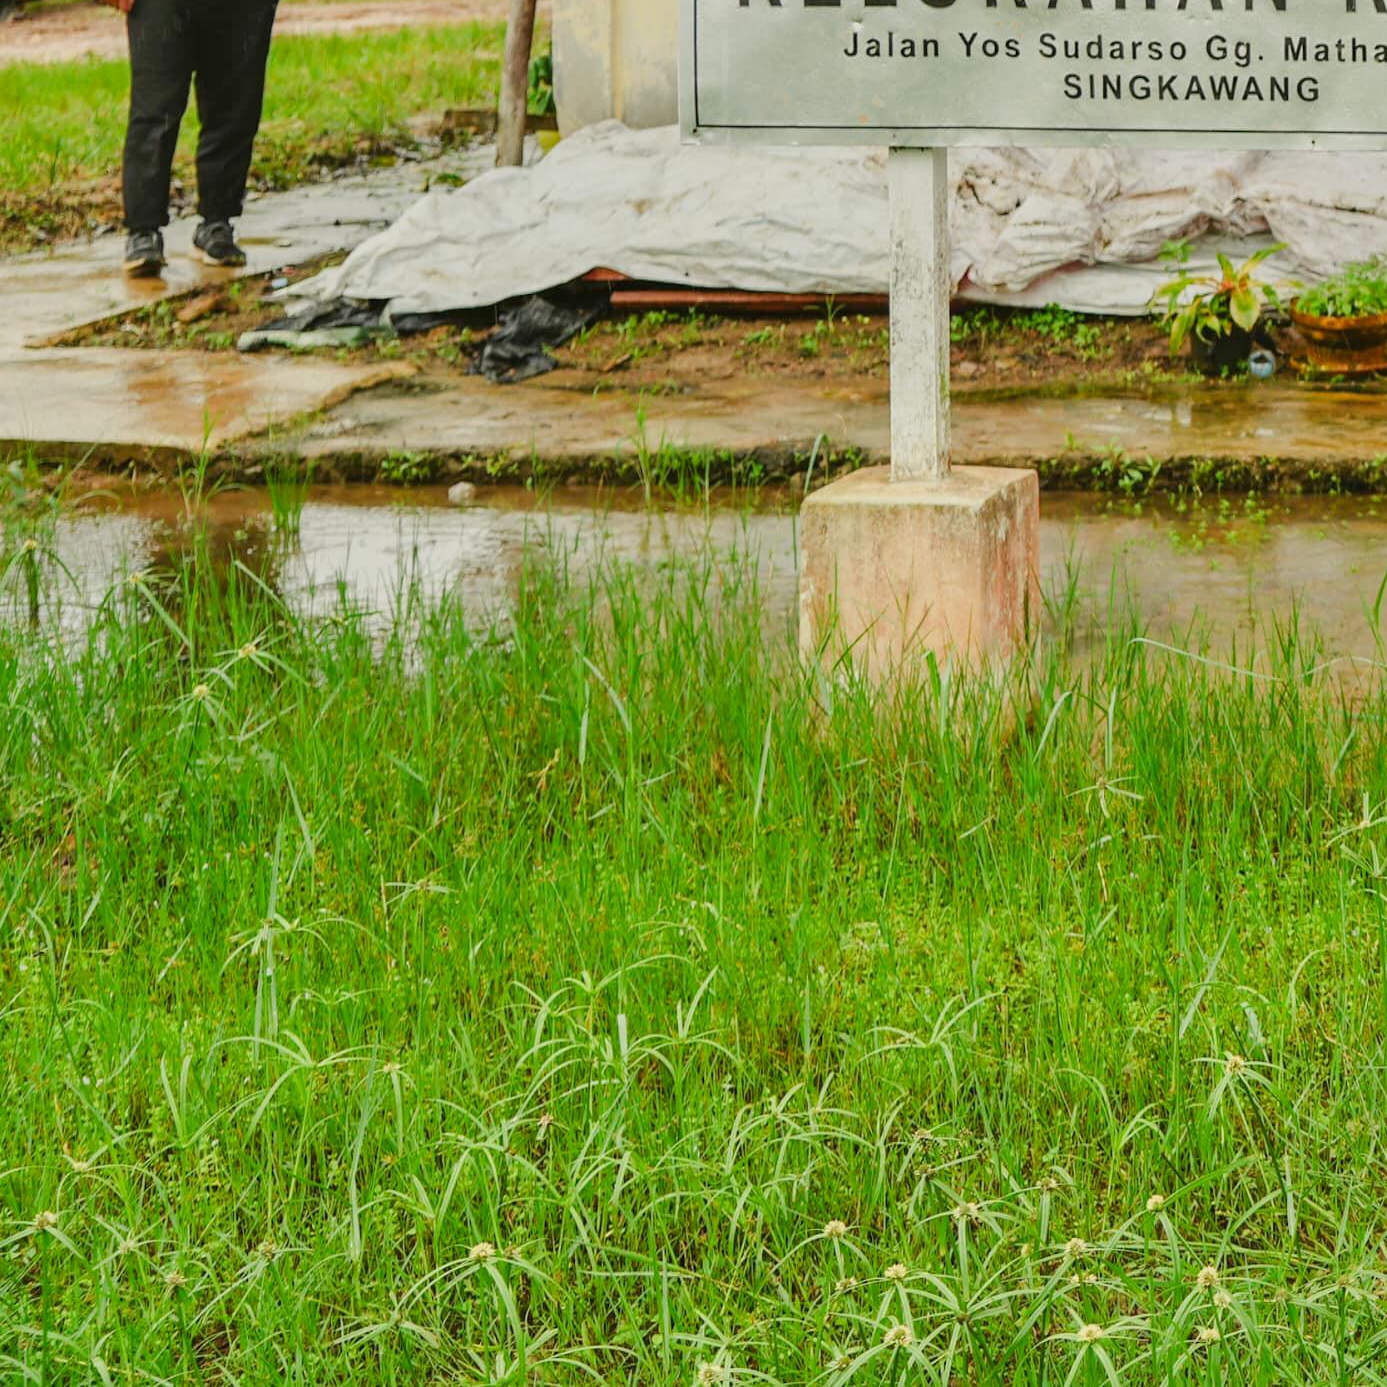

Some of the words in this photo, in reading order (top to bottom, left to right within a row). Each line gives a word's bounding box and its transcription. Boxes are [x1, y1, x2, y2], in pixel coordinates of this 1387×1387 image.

[843, 30, 940, 59] Jalan
[957, 31, 1021, 60] Yos
[1038, 32, 1187, 61] Sudarso
[1205, 34, 1265, 70] Gg.
[1063, 73, 1320, 103] SINGKAWANG
